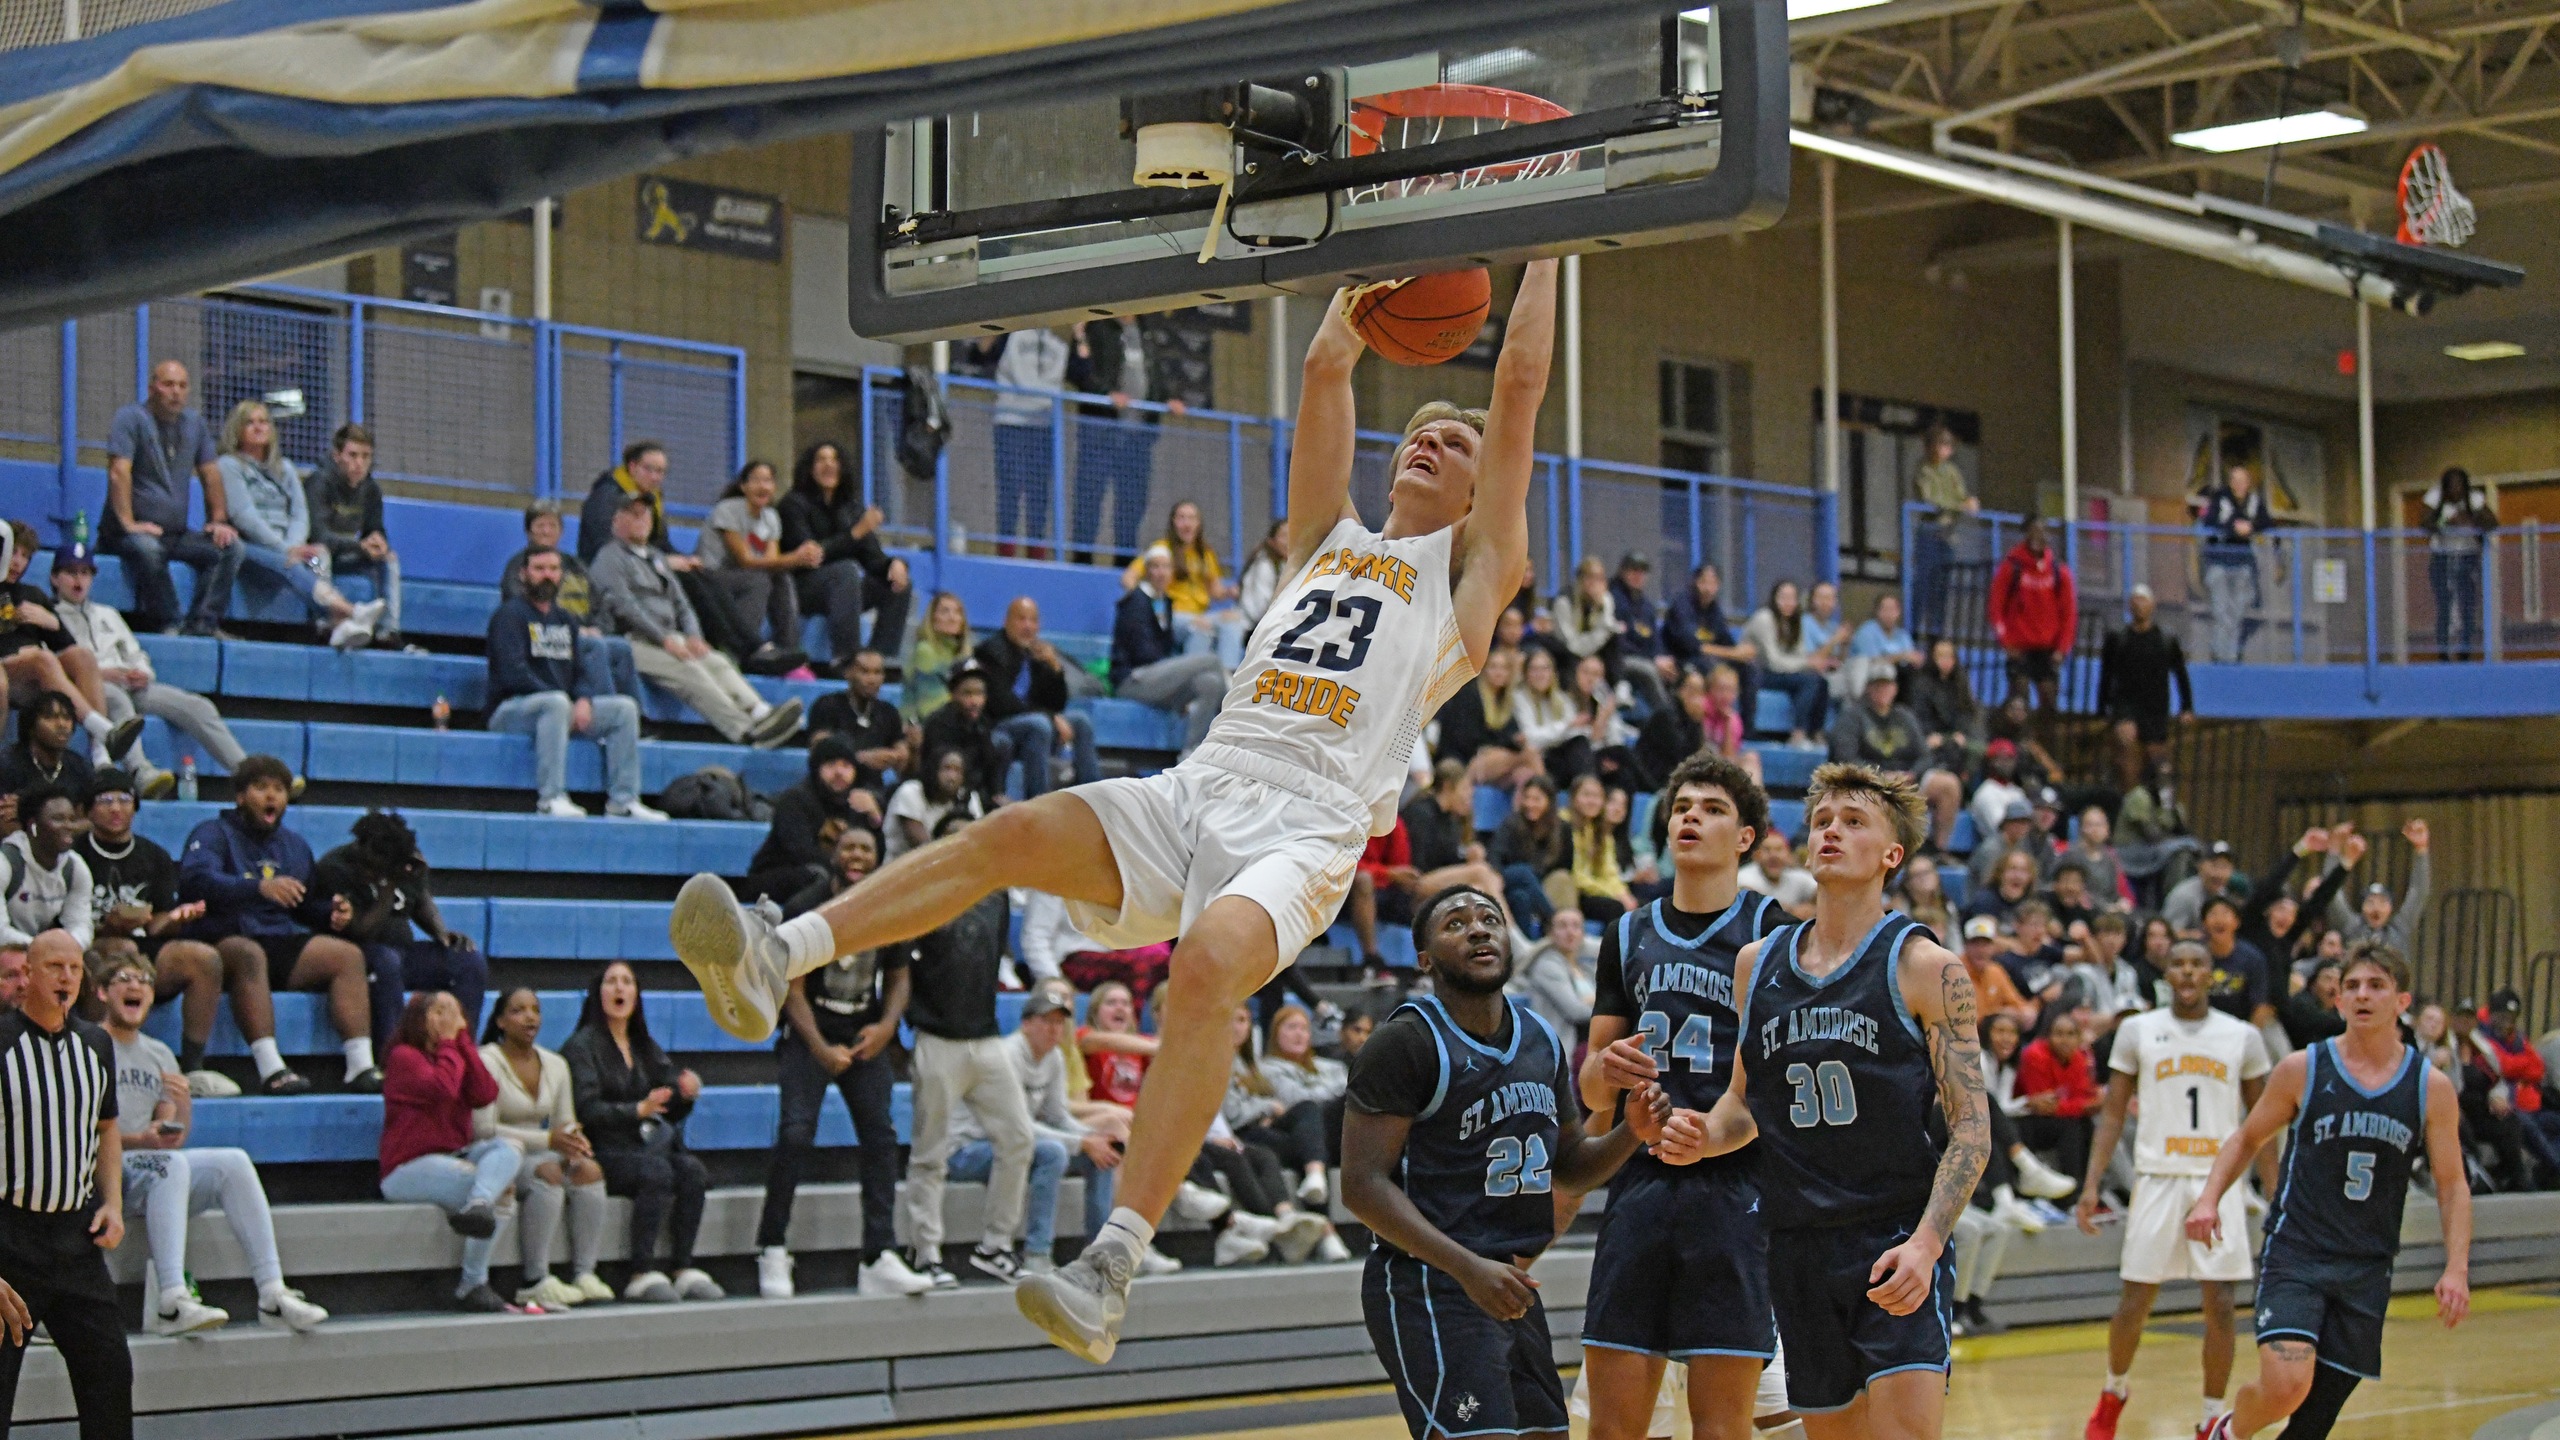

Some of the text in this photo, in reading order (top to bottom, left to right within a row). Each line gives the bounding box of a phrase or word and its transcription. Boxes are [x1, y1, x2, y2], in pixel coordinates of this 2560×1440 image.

[1296, 548, 1417, 605] CLARKE
[1272, 589, 1383, 672] 23
[1252, 669, 1361, 728] PRIDE
[1638, 1011, 1714, 1073] 24
[1761, 1007, 1879, 1060] ST. AMBROSE
[1786, 1060, 1858, 1128] 30
[2155, 1053, 2228, 1082] CLARKE
[1459, 1098, 1486, 1140] ST.
[2186, 1087, 2198, 1130] 1
[1484, 1133, 1552, 1196] 22
[2344, 1150, 2377, 1202] 5
